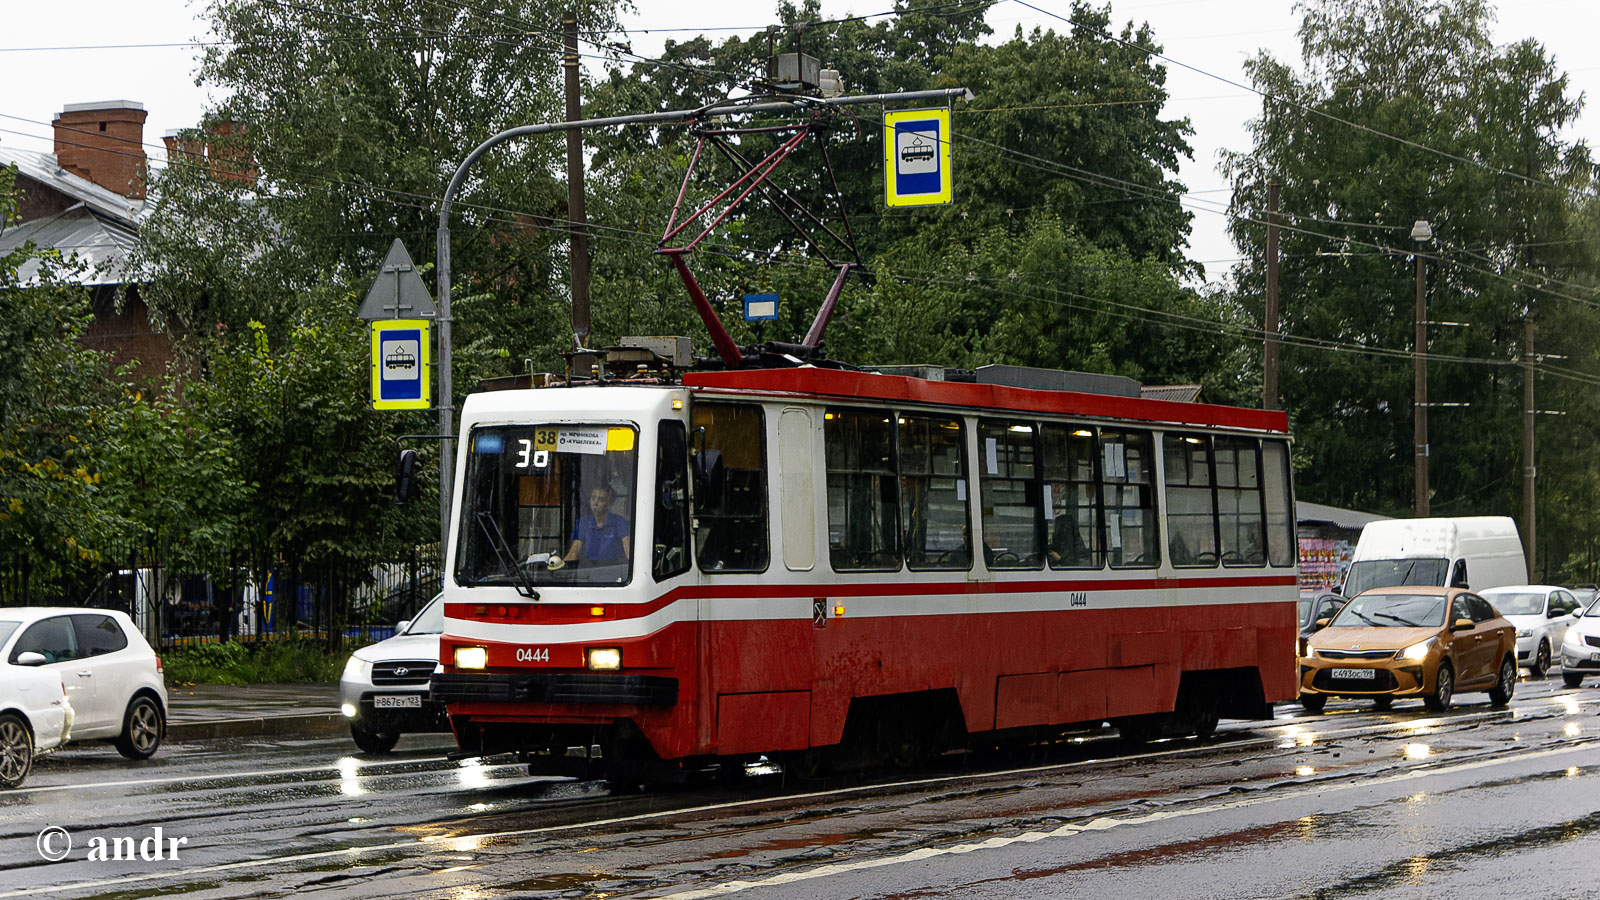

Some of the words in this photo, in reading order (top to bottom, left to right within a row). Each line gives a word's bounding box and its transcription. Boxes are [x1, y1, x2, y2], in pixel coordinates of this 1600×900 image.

[537, 431, 556, 445] 38
[1070, 592, 1087, 607] 0444
[516, 648, 550, 662] 0444
